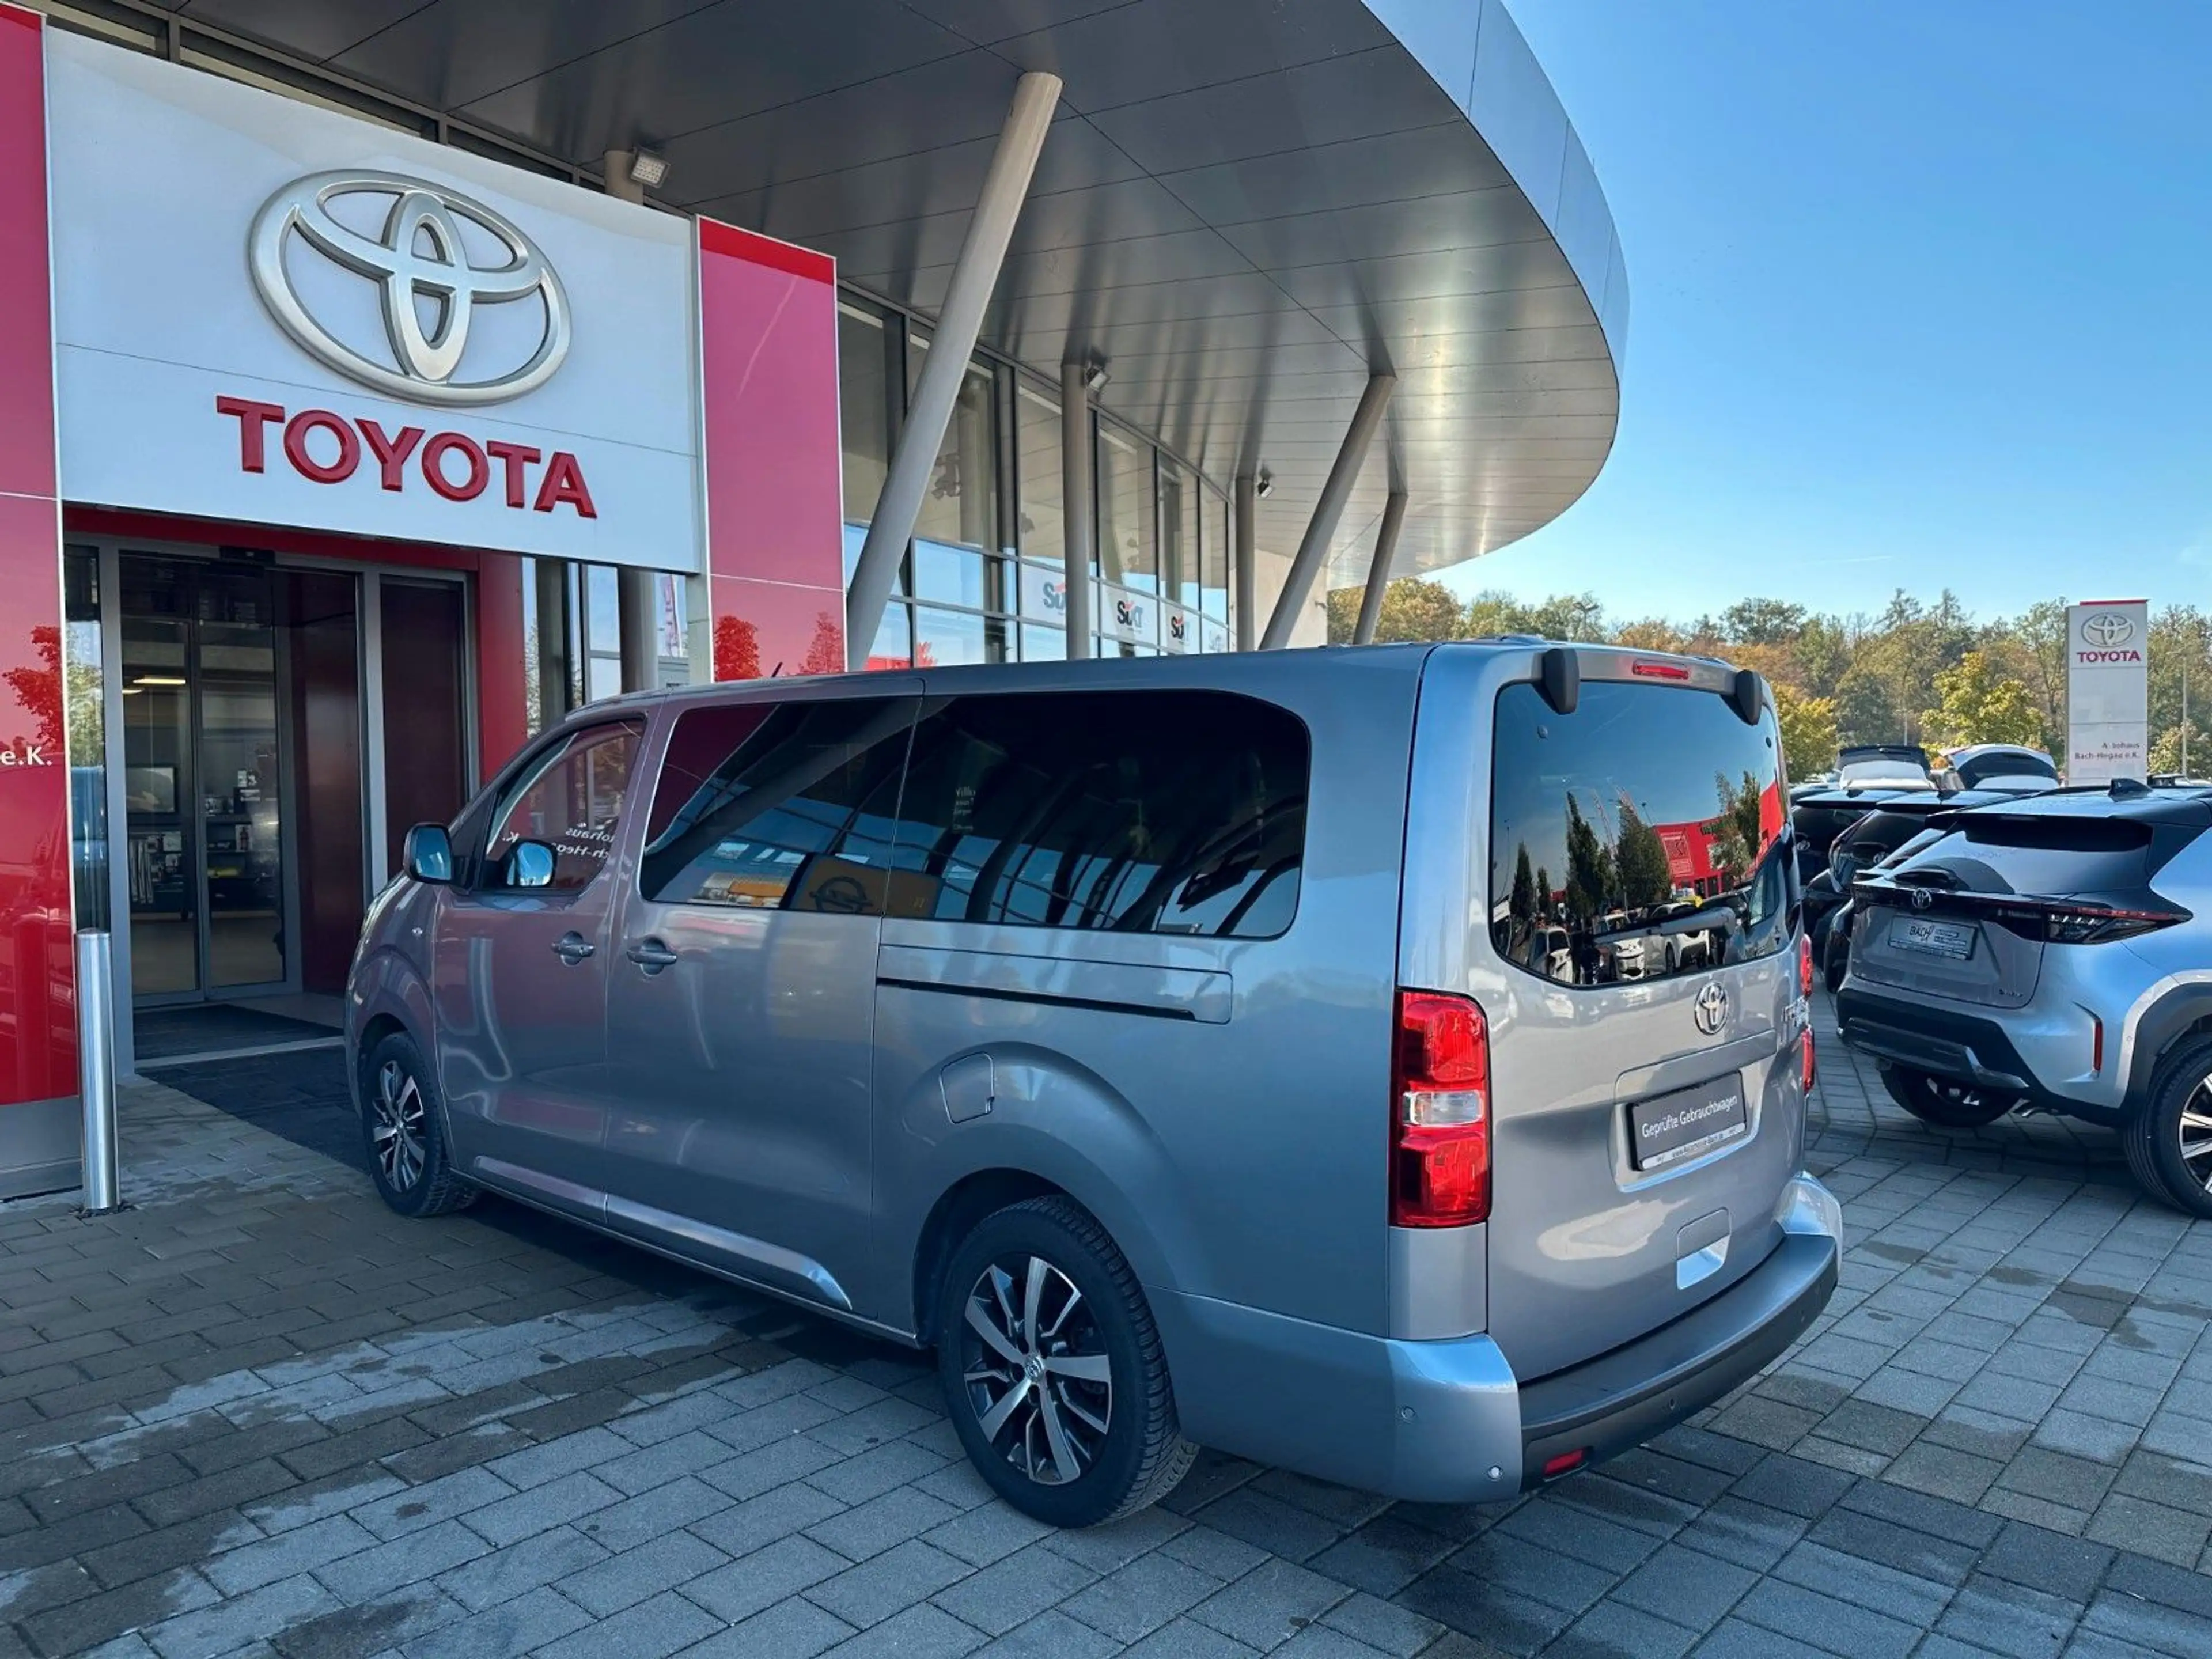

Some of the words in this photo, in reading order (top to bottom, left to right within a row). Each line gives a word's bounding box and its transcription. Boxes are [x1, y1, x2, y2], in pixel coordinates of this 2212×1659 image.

[217, 396, 597, 519] TOYOTA
[1043, 582, 1065, 609] Si
[2077, 650, 2141, 663] TOYOTA
[1, 745, 52, 766] e.K.
[1642, 1114, 1679, 1138] Geprüfte
[1679, 1095, 1738, 1125] Gebrauchtwagen
